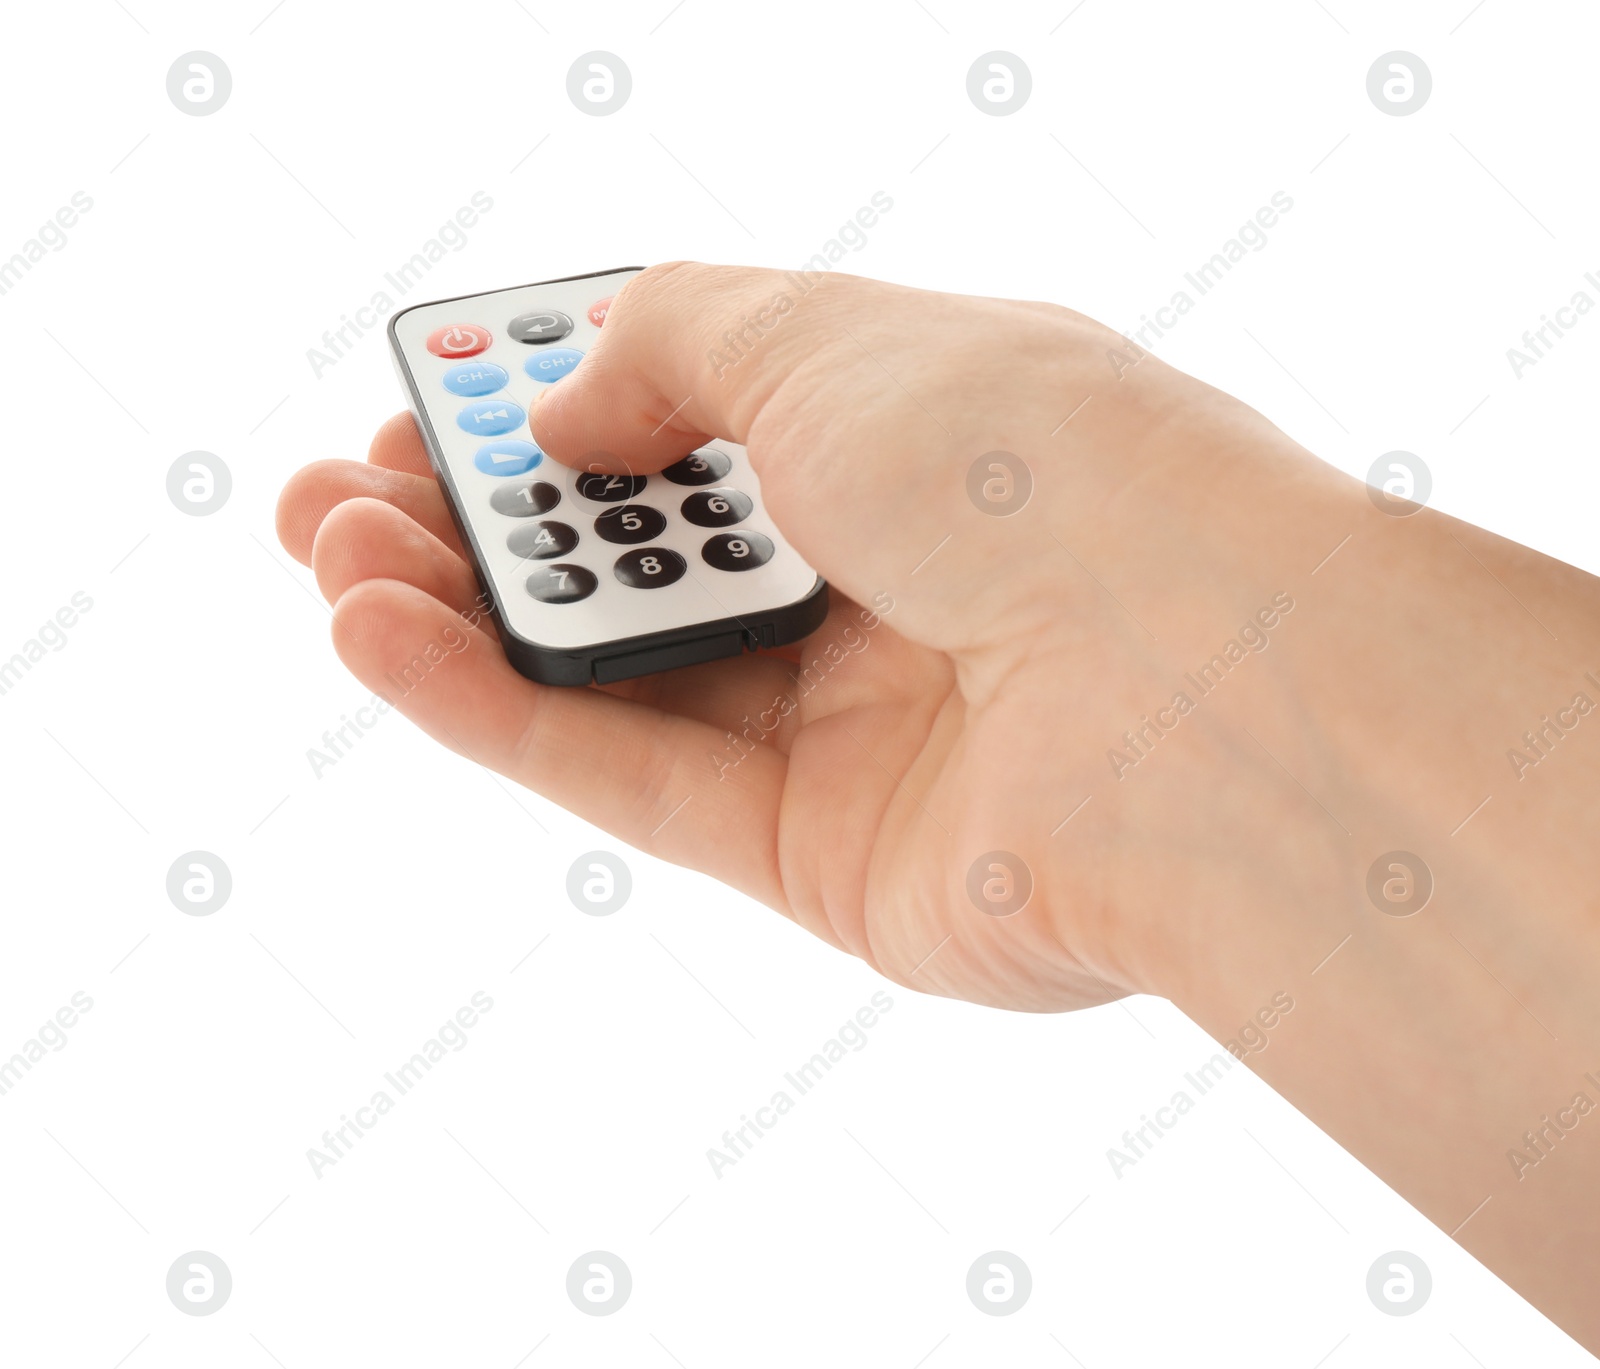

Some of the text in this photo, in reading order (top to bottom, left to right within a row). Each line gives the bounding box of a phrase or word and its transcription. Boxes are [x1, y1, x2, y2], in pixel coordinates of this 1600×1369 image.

[539, 356, 577, 370] CH+
[456, 371, 494, 384] CH-
[686, 456, 709, 472] 3
[605, 474, 625, 490] 2
[516, 487, 534, 505] 1
[707, 496, 730, 514] 6
[621, 512, 643, 531] 5
[534, 528, 556, 546] 4
[727, 539, 750, 558] 9
[639, 556, 663, 575] 8
[549, 571, 570, 590] 7
